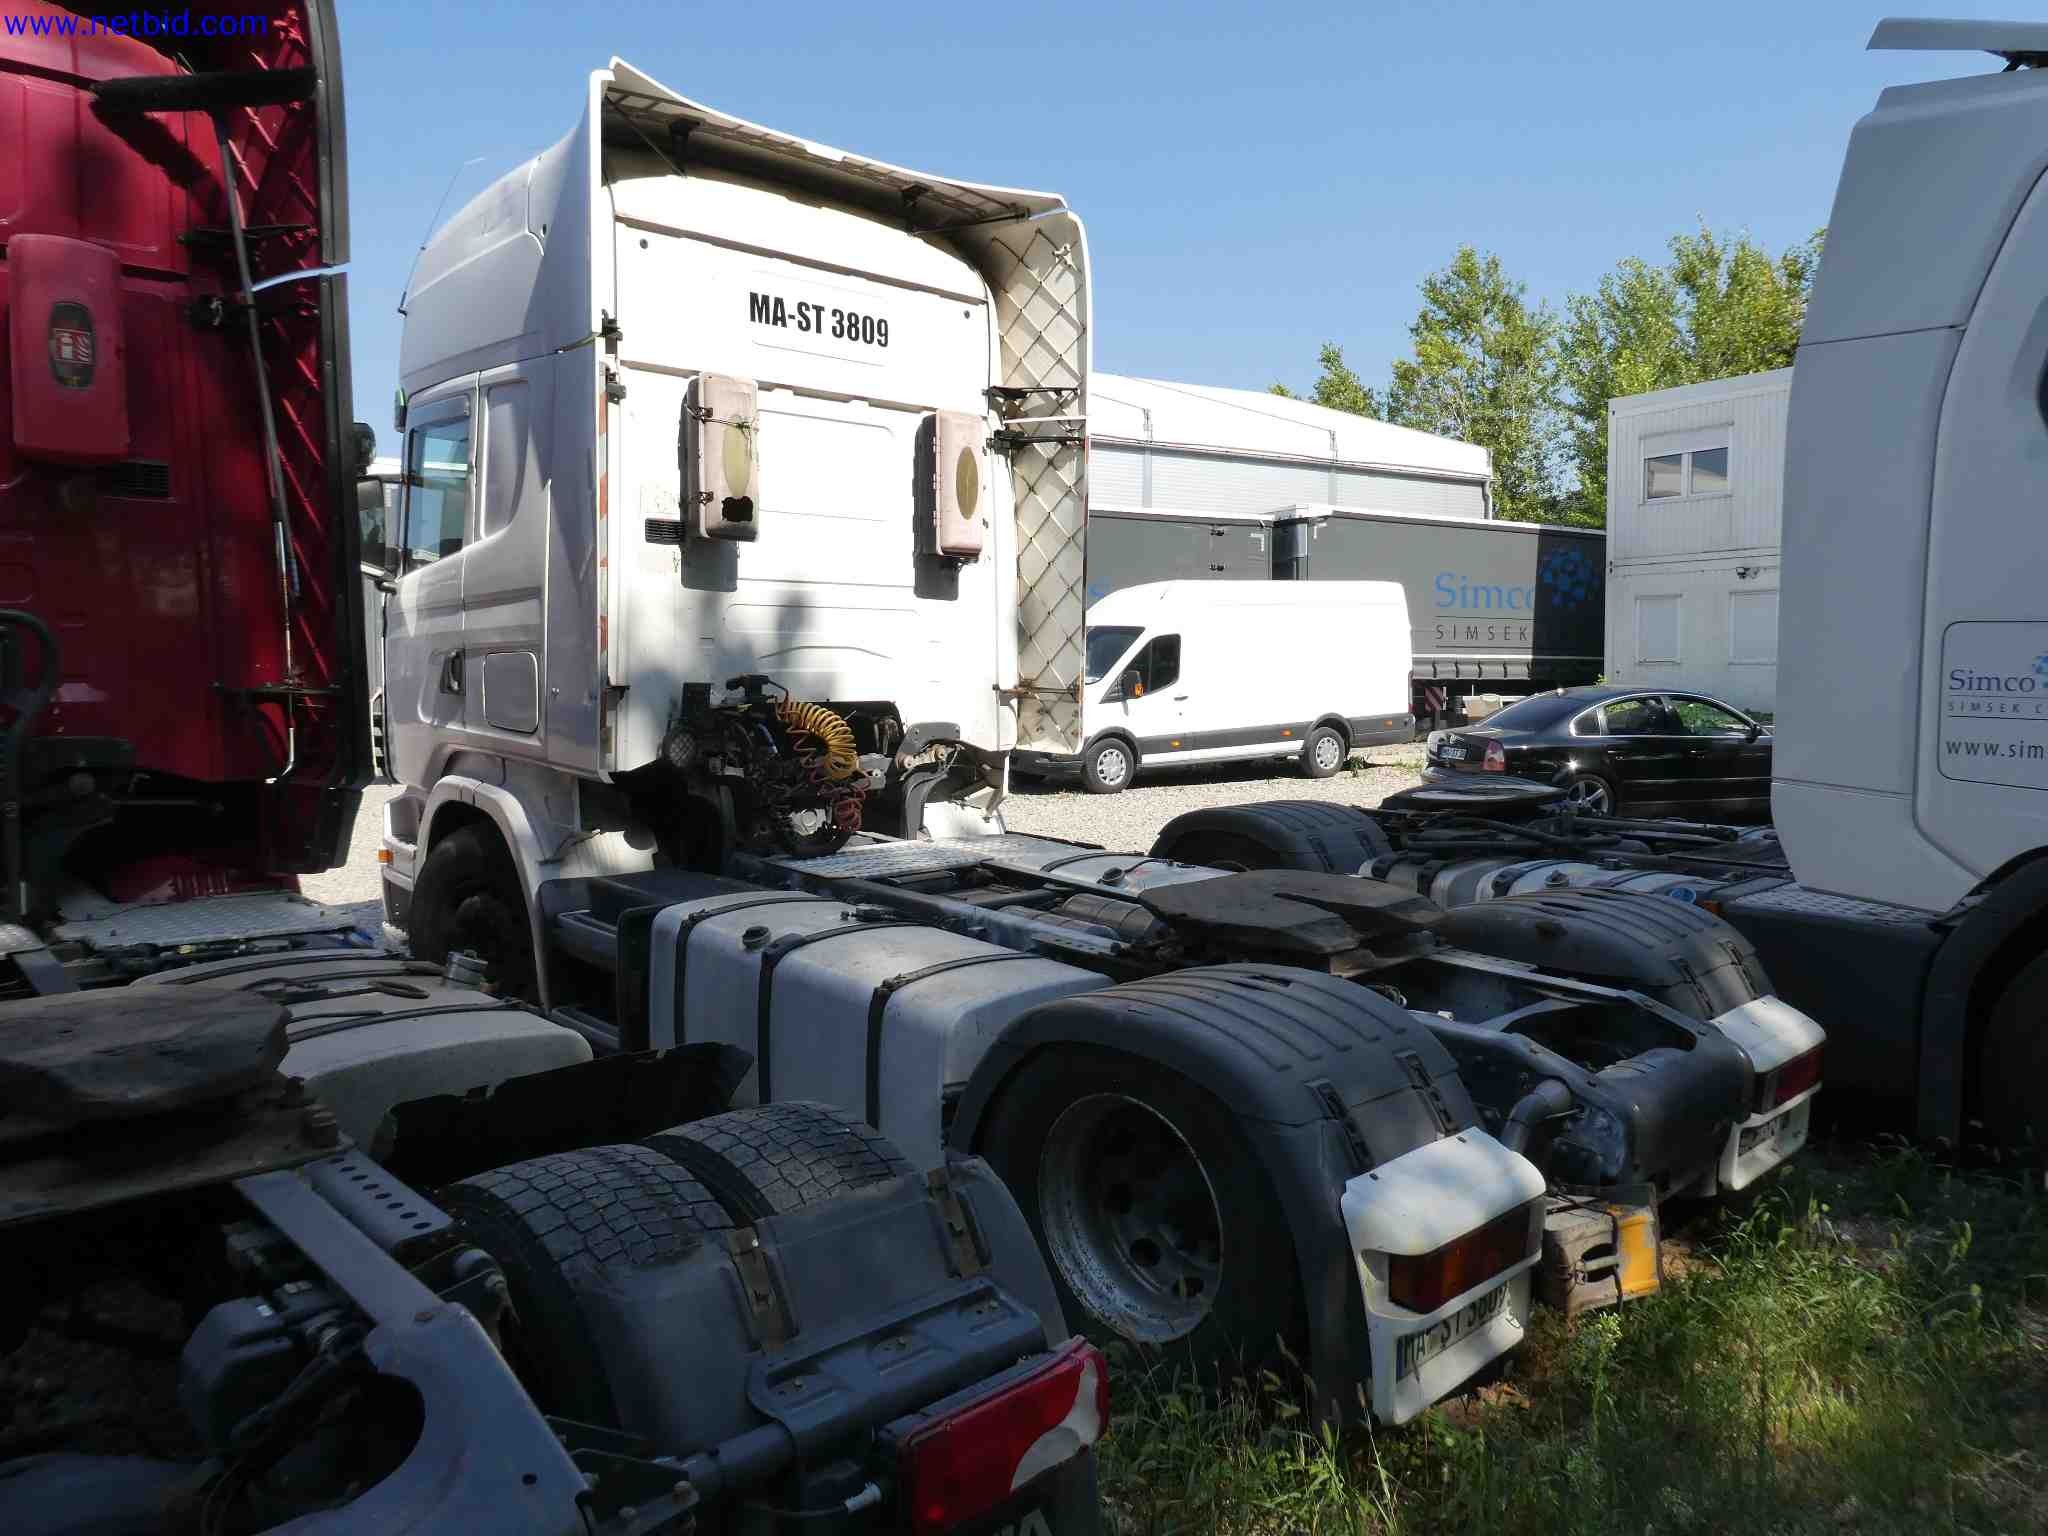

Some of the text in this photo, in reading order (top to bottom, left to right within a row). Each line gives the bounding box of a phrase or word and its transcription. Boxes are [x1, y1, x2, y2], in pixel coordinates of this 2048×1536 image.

[749, 291, 889, 347] MA-ST 3809
[1434, 624, 1528, 642] SIMSEK
[1949, 668, 2036, 693] Simco
[1947, 701, 2021, 713] SIMSEK
[1945, 740, 2048, 760] www.sim
